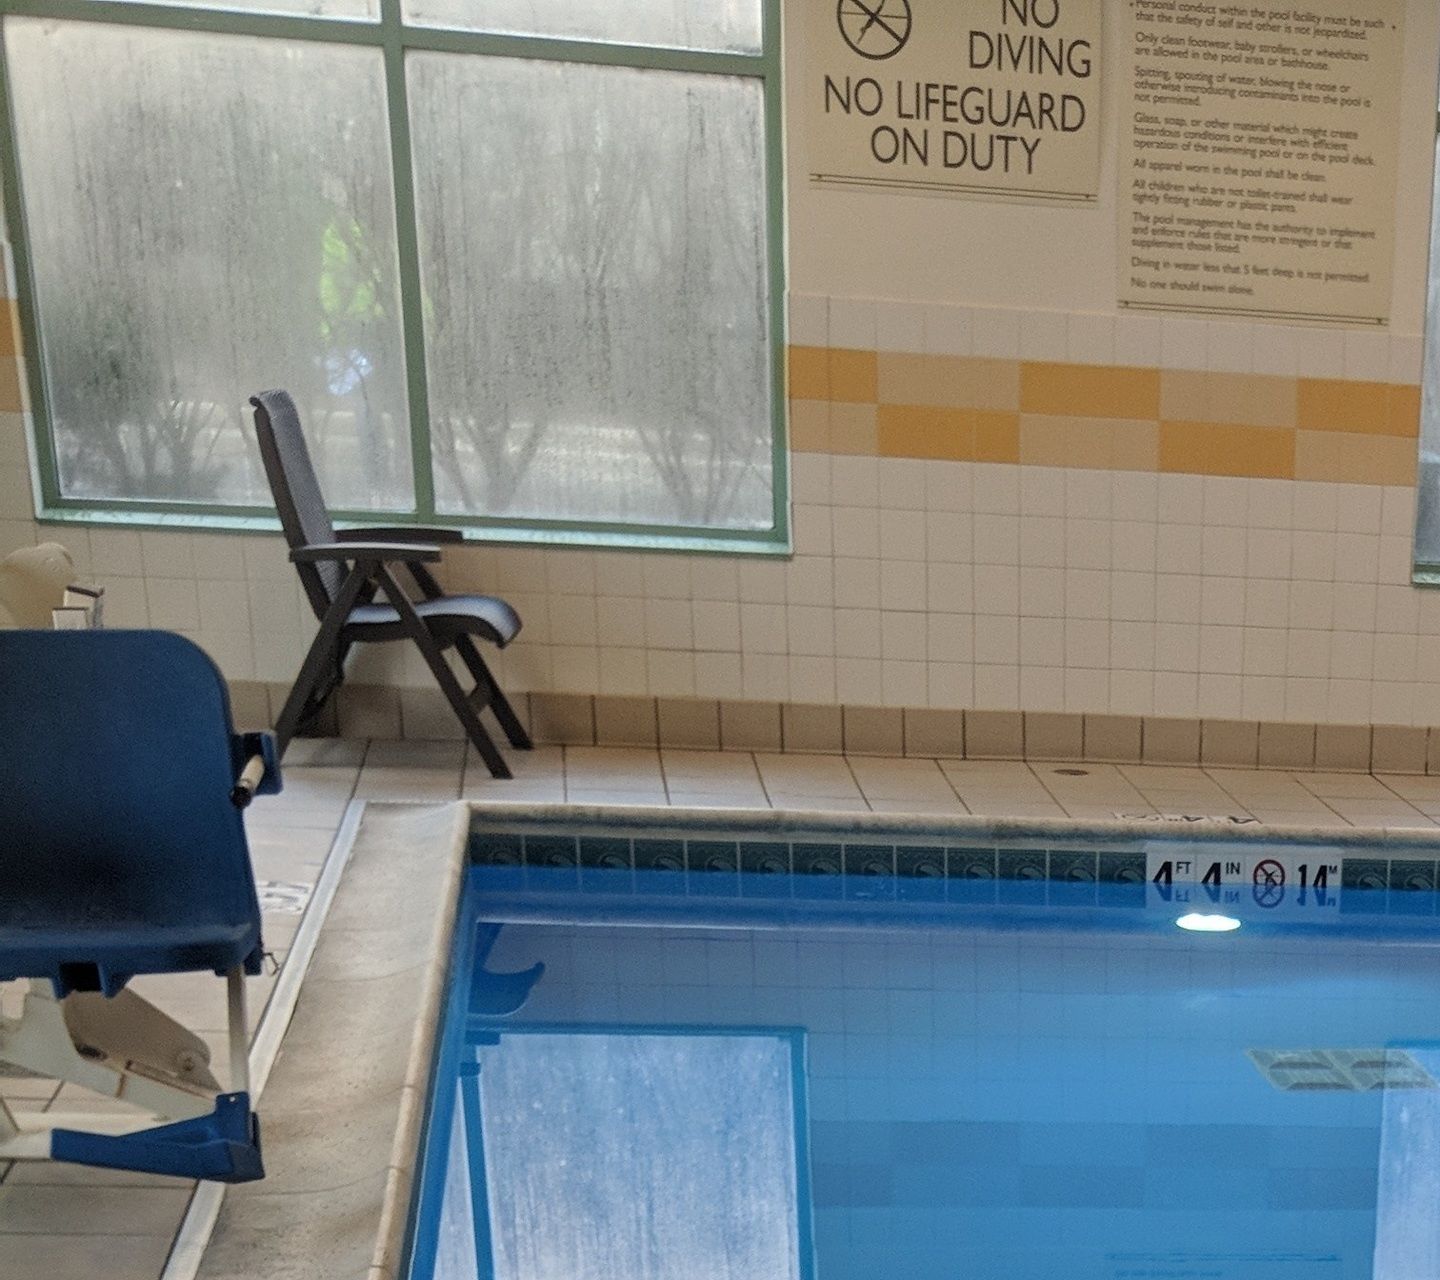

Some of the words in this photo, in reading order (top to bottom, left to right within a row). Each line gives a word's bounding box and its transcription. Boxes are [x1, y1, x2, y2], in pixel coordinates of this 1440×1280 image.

[1001, 0, 1059, 28] NO
[1268, 10, 1290, 22] pool
[969, 31, 1091, 78] DIVING
[1220, 53, 1241, 65] pool
[824, 75, 883, 116] NO
[897, 81, 1087, 132] LIFEGUARD
[1339, 97, 1361, 109] pool
[871, 126, 928, 166] ON
[943, 133, 1041, 174] DUTY
[1259, 147, 1280, 159] pool
[1328, 152, 1349, 164] pool
[1241, 167, 1262, 179] pool
[1153, 214, 1173, 226] pool
[1176, 862, 1191, 874] FT
[1226, 862, 1241, 875] IN
